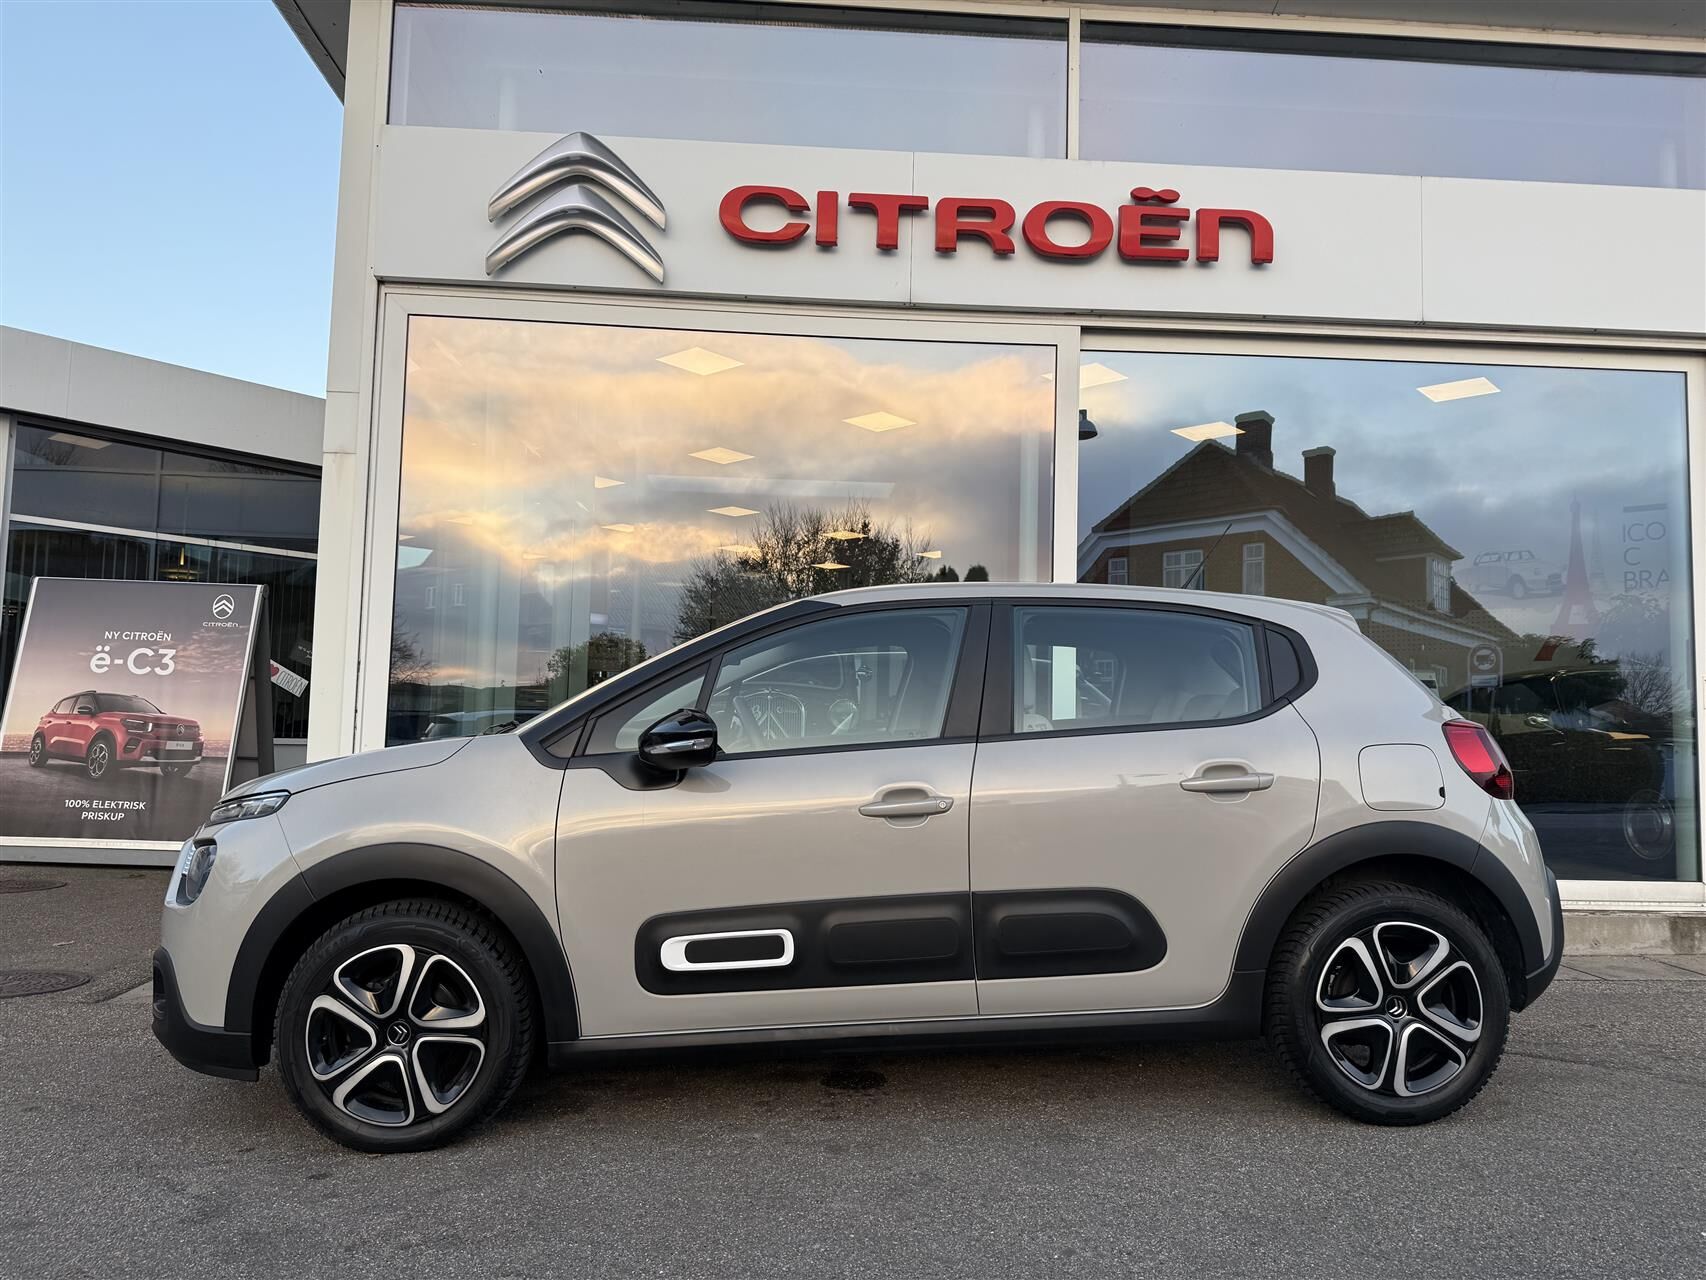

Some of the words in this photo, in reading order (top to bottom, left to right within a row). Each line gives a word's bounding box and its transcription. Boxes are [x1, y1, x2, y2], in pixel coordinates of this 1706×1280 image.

[104, 631, 120, 640] NY
[122, 630, 172, 641] CITROËN
[90, 645, 176, 675] ë-C3
[64, 799, 90, 809] 100%
[92, 800, 146, 810] ELEKTRISK
[81, 811, 125, 821] PRISKUP
